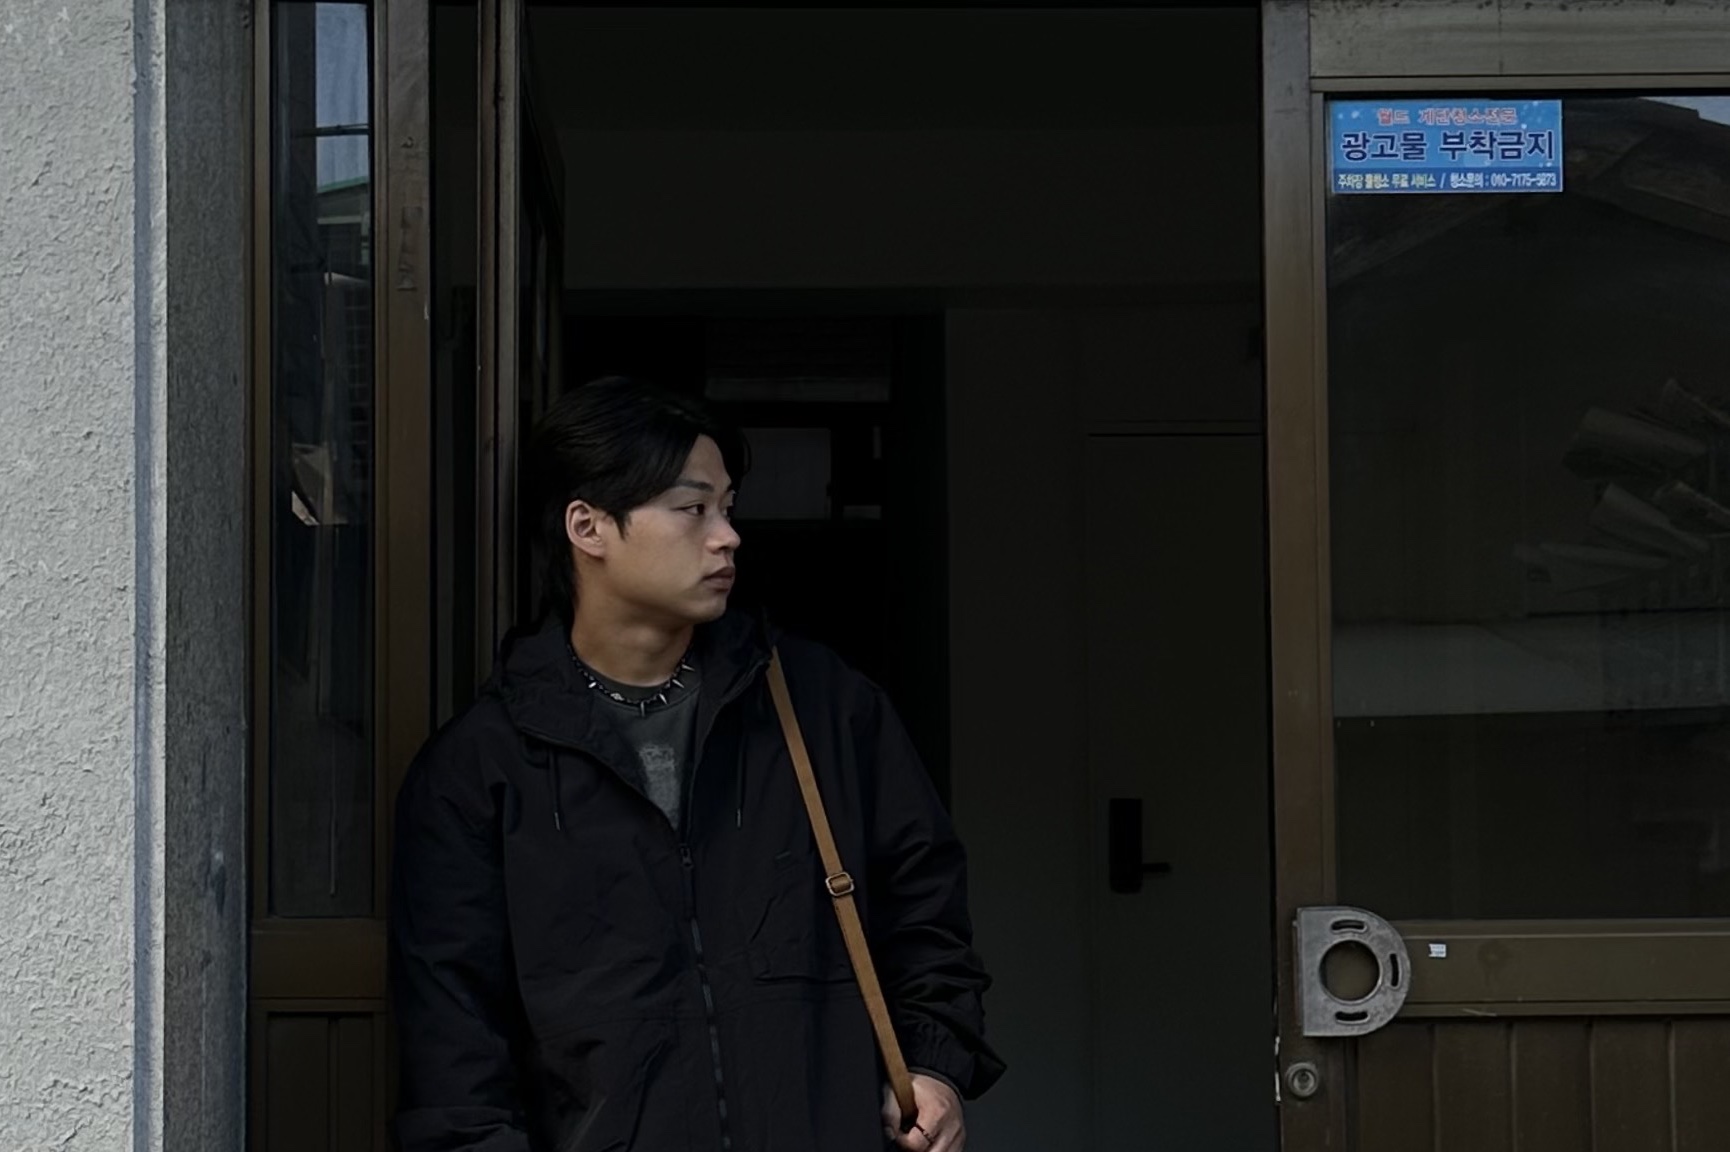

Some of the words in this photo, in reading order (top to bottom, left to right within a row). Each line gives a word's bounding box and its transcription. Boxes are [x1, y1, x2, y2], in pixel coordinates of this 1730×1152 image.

[1341, 131, 1428, 162] 광고물
[1438, 130, 1554, 161] 부착금지
[1338, 173, 1363, 189] 주차장
[1391, 173, 1409, 188] 무료
[1411, 173, 1436, 188] 서비스
